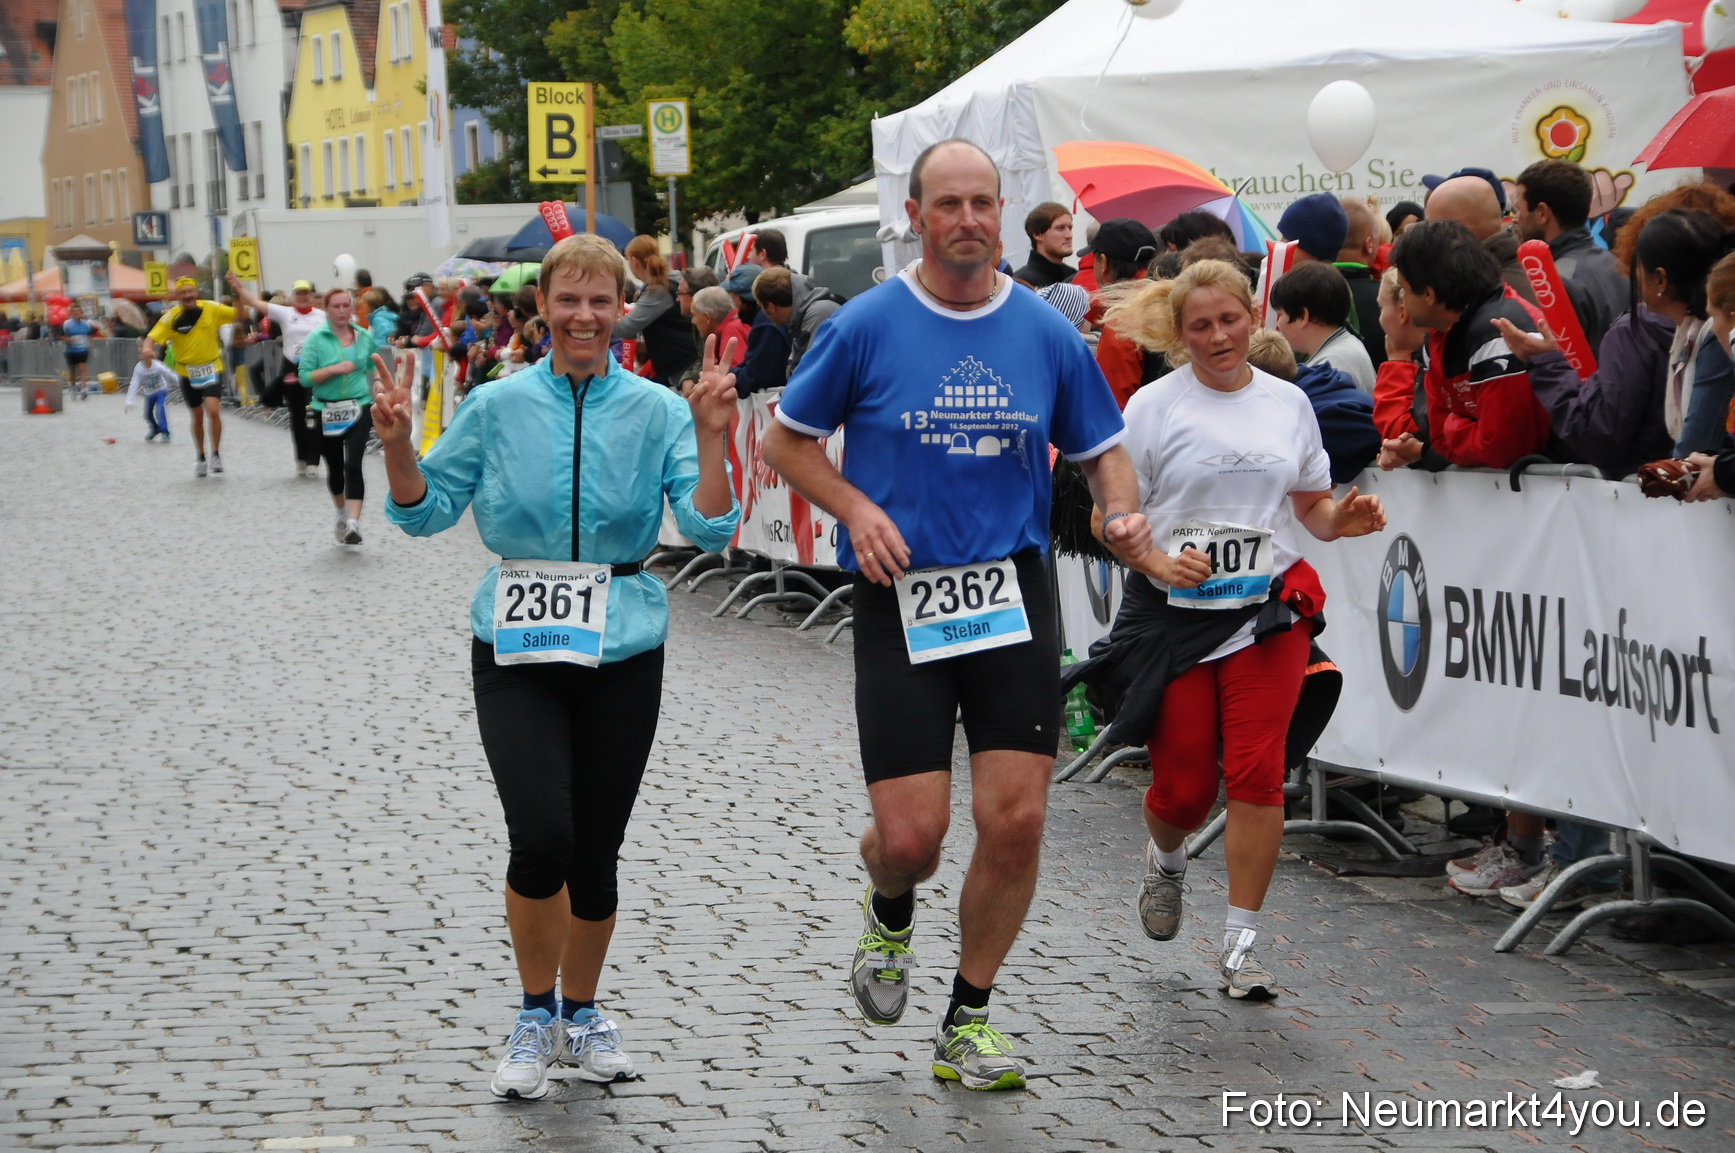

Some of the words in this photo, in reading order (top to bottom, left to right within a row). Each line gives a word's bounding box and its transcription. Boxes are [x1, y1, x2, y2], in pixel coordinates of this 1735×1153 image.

[536, 87, 585, 104] Block
[1543, 80, 1562, 91] UND
[1564, 79, 1606, 103] EINSAMEN
[1514, 87, 1542, 120] KRANKEN
[324, 107, 346, 130] HOTEL
[661, 111, 675, 128] H
[1601, 102, 1616, 139] KINDERN
[546, 112, 577, 160] B
[1512, 122, 1520, 144] HILFT
[1368, 158, 1424, 188] Sie.
[230, 239, 254, 248] Block
[236, 250, 251, 271] C
[151, 271, 162, 287] D
[326, 410, 356, 422] 2621
[900, 410, 936, 430] 13.
[930, 410, 993, 420] Neumarkter
[994, 410, 1039, 423] Stadtlauf
[949, 423, 1000, 431] 16.September
[1172, 528, 1206, 537] PARTL
[1381, 539, 1427, 598] BMW
[910, 566, 1010, 620] 2362
[1197, 583, 1244, 597] Sabine
[505, 581, 593, 624] 2361
[522, 631, 570, 648] Sabine
[942, 621, 991, 642] Stefan
[1444, 585, 1548, 691] BMW
[1558, 597, 1720, 742] Laufsport
